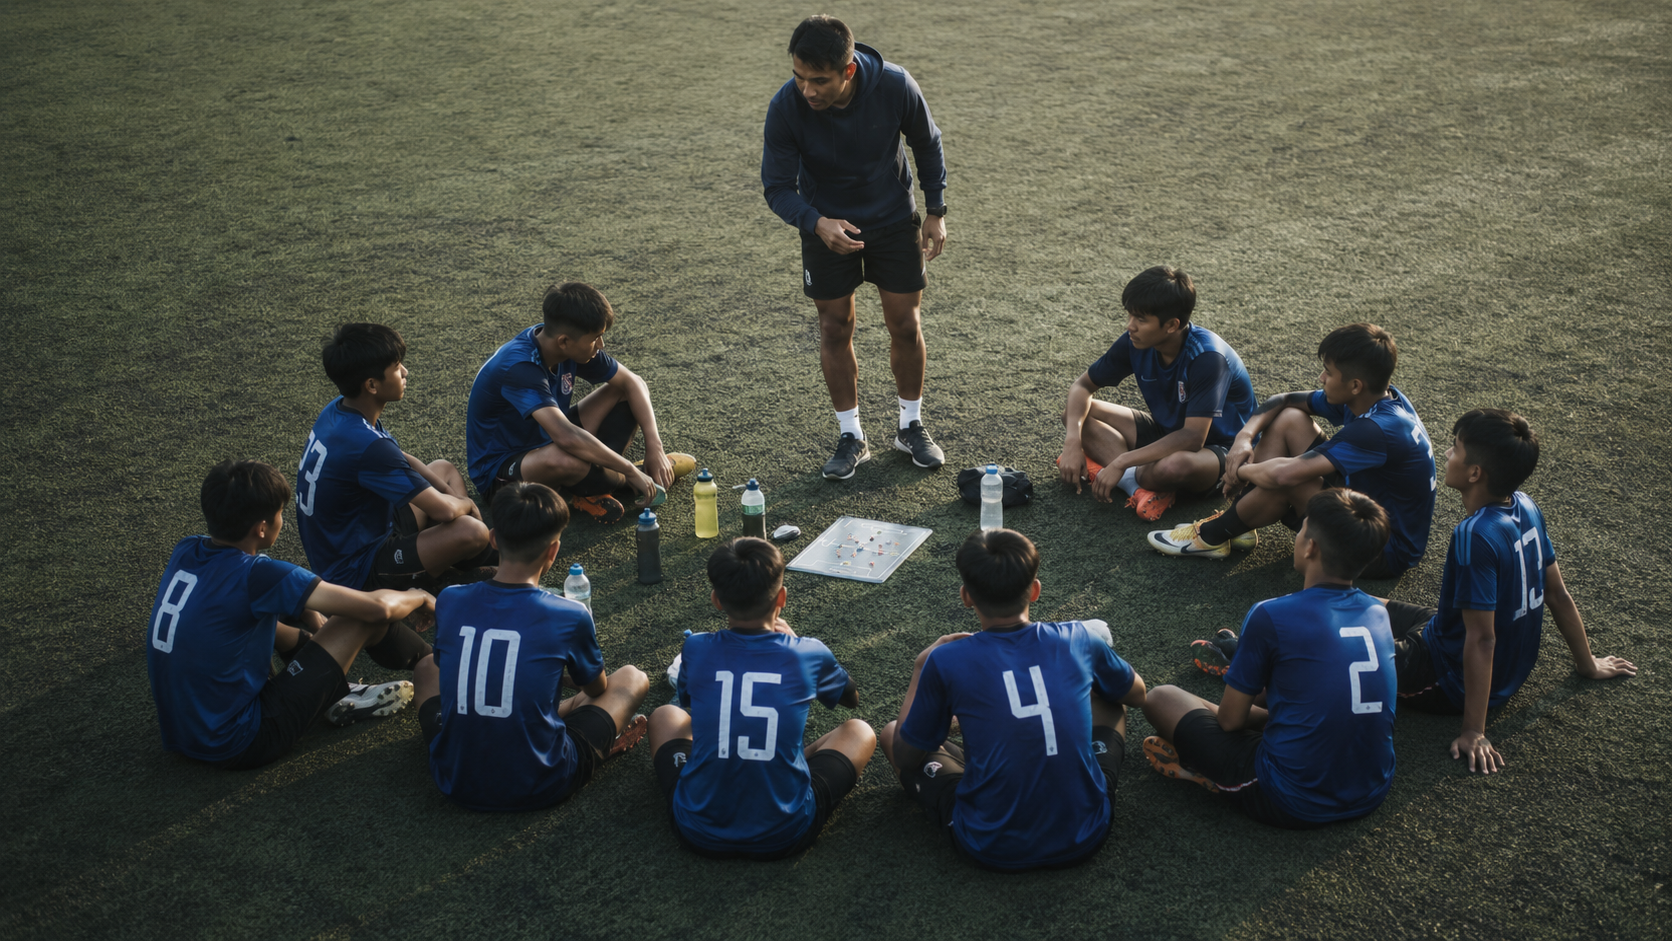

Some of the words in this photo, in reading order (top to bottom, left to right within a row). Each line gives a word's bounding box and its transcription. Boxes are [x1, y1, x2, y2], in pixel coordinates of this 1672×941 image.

[152, 569, 198, 654] 8
[457, 625, 522, 718] 10
[715, 670, 782, 762] 15
[1002, 664, 1058, 756] 4
[1339, 626, 1383, 714] 2
